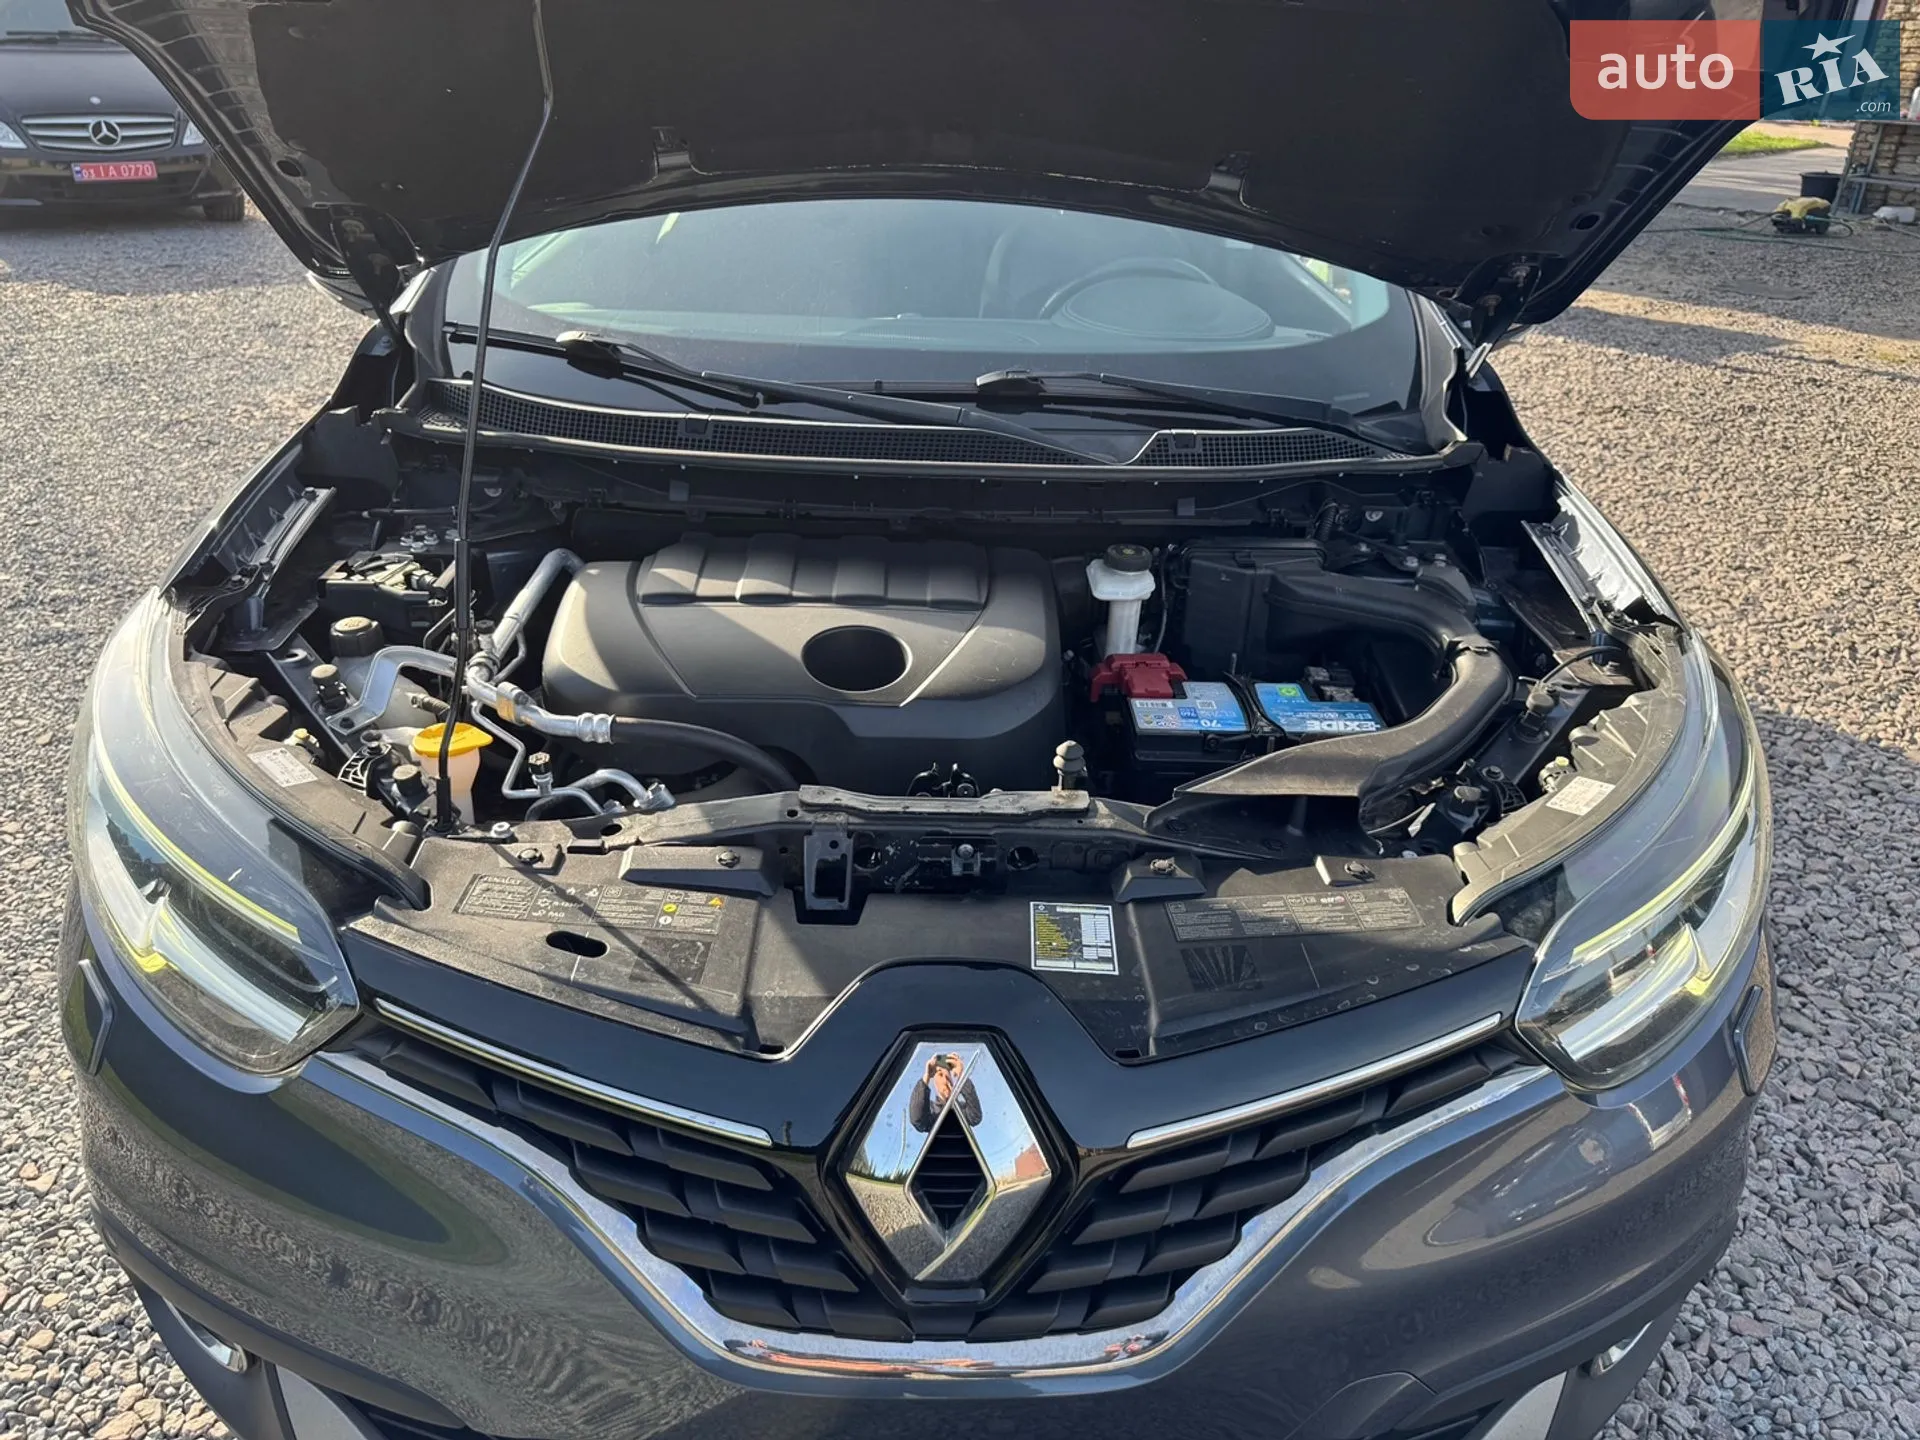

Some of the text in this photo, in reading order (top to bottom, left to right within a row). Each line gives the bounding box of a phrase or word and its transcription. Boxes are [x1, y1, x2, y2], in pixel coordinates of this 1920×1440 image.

[120, 164, 152, 177] 0770
[1200, 718, 1222, 728] 70
[1306, 720, 1381, 732] EXIDE
